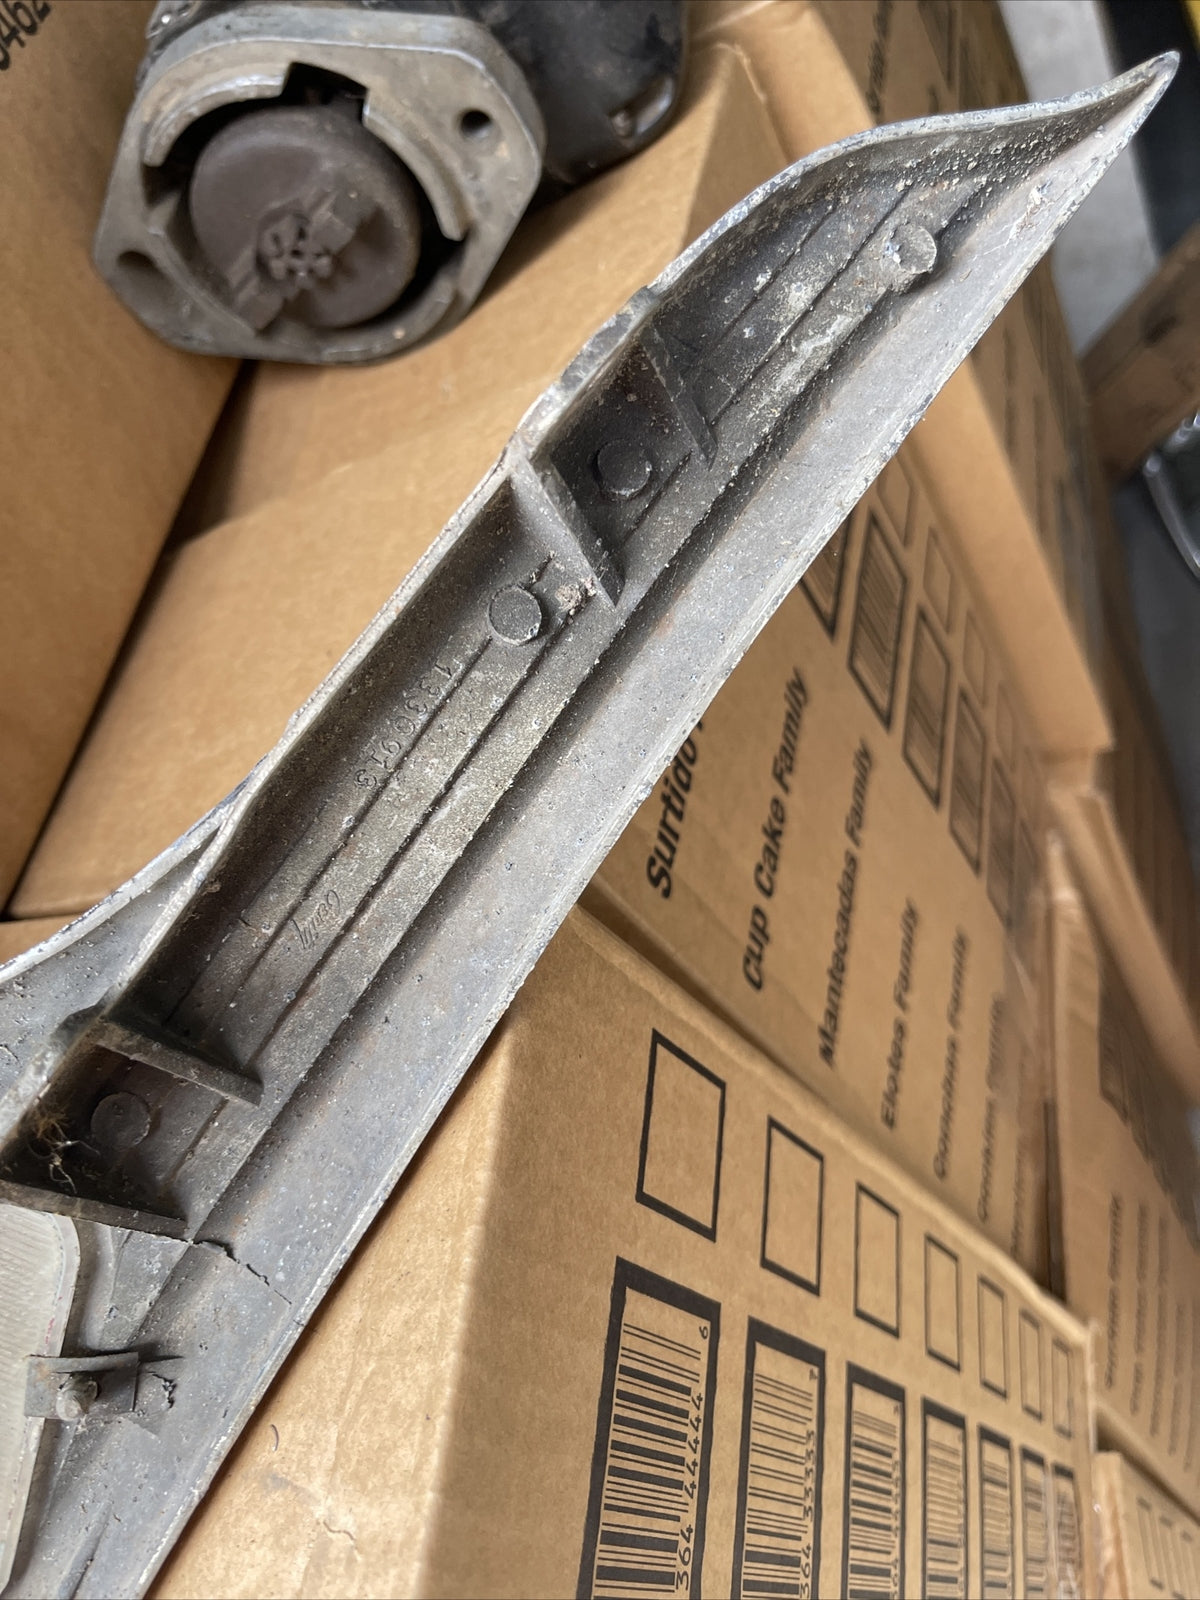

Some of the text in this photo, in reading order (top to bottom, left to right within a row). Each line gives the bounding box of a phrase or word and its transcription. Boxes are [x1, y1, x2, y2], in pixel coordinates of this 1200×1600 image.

[647, 735, 698, 899] Surtido
[743, 667, 808, 991] Cup Cake Family
[818, 739, 873, 1069] Mantecadas Family
[881, 899, 919, 1131] Elotes Family
[675, 1326, 708, 1591] 364 44444 6
[800, 1545, 812, 1599] 364
[804, 1430, 816, 1516] 33333
